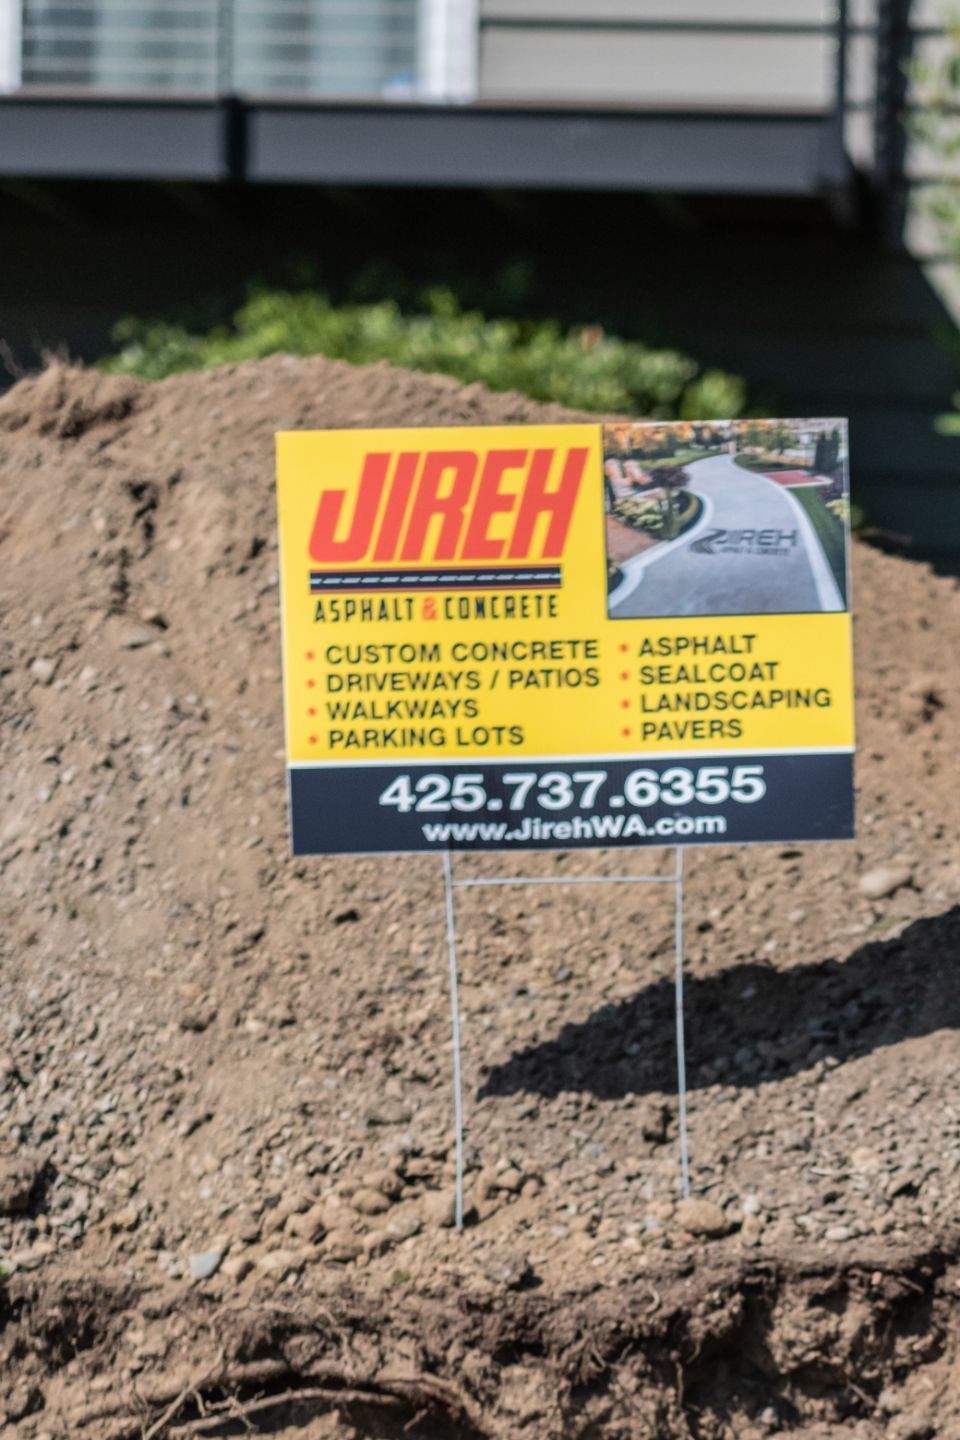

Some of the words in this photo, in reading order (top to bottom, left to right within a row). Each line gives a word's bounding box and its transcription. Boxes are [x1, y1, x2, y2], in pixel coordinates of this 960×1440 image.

[309, 447, 589, 563] JIREH
[315, 598, 413, 622] ASPHALT
[422, 597, 437, 621] &
[445, 594, 557, 620] CONCRETE
[326, 644, 440, 665] CUSTOM
[451, 640, 598, 662] CONCRETE
[639, 634, 756, 657] ASPHALT
[327, 671, 480, 693] DRIVEWAYS
[509, 667, 600, 688] PATIOS
[640, 661, 778, 685] SEALCOAT
[327, 699, 479, 720] WALKWAYS
[642, 688, 831, 713] LANDSCAPING
[329, 727, 446, 748] PARKING
[456, 726, 524, 746] LOTS
[642, 719, 742, 740] PAVERS
[379, 765, 767, 812] 425.737.6355
[422, 812, 728, 842] www.JirehWA.com
